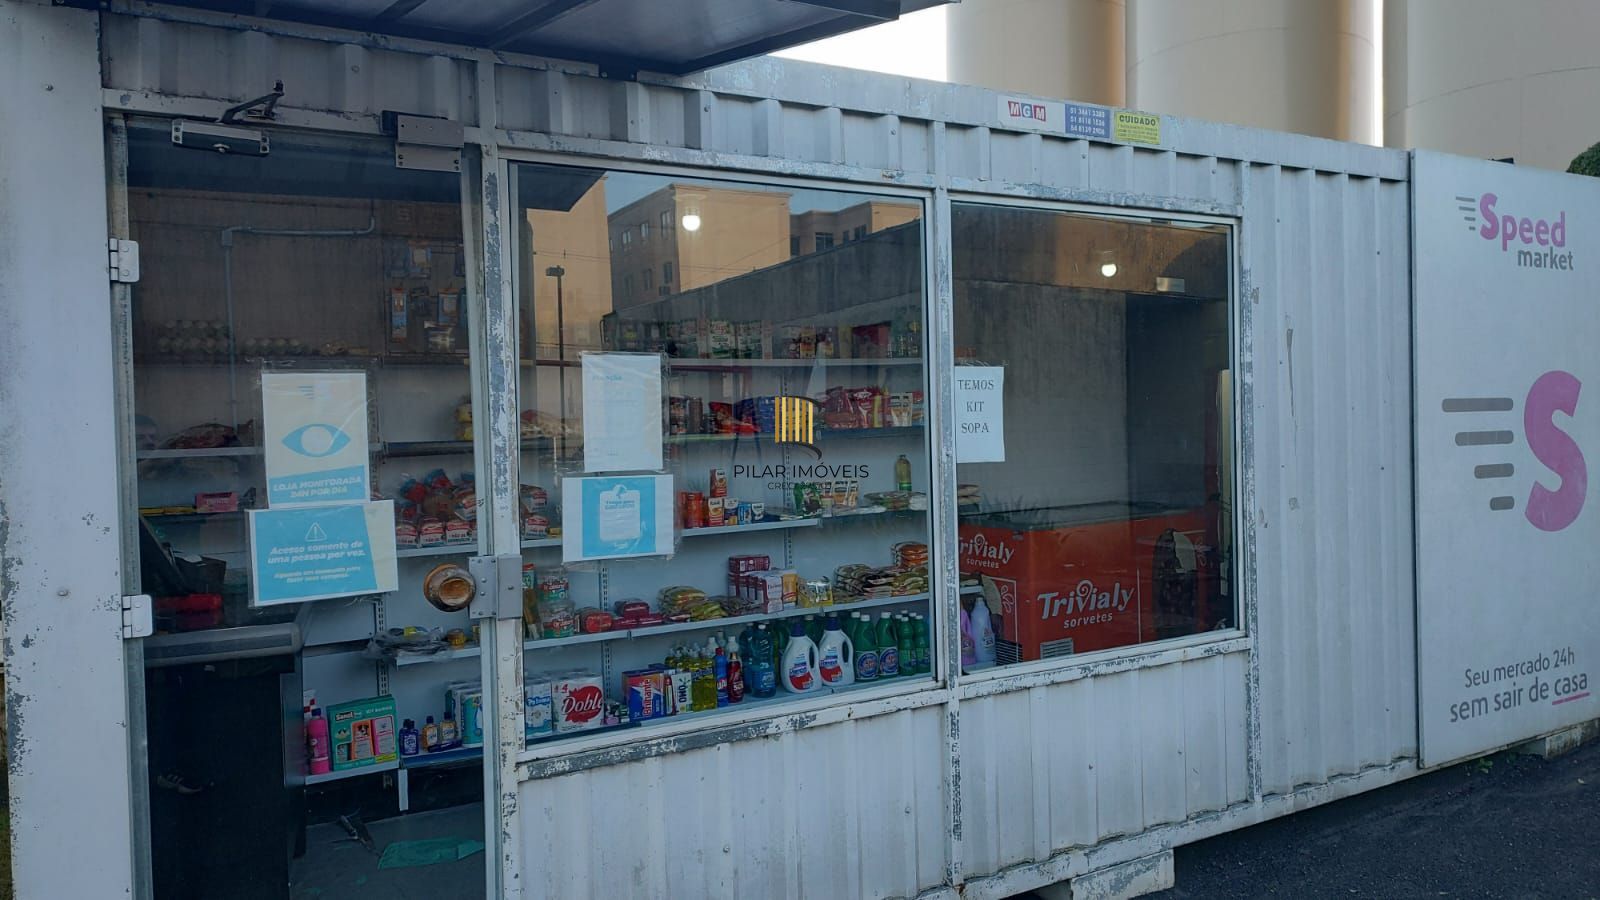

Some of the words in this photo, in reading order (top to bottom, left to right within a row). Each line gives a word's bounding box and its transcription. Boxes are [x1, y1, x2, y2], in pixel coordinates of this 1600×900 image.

[1009, 102, 1046, 121] MGM
[1119, 115, 1156, 126] CUIDADO
[1480, 192, 1566, 251] Speed
[1517, 246, 1574, 271] market
[957, 380, 995, 390] TEMOS
[966, 401, 985, 412] KIT
[961, 422, 990, 433] SOPA
[273, 480, 298, 492] LOJA
[299, 476, 362, 488] MONITORADA
[270, 545, 305, 555] Acesso
[307, 541, 349, 552] somente
[350, 540, 363, 548] de
[959, 533, 1015, 564] rivialy
[268, 555, 289, 564] uma
[291, 553, 326, 564] pessoa
[327, 551, 346, 561] por
[347, 549, 366, 557] vez.
[966, 557, 1000, 568] sorvetes
[1037, 579, 1135, 620] Trivialy
[1063, 612, 1113, 628] sorvetes
[1465, 668, 1490, 688] Seu
[1493, 653, 1550, 682] mercado
[1553, 646, 1575, 668] 24h
[679, 684, 687, 703] OMO
[1450, 696, 1488, 722] sem
[1494, 682, 1523, 711] sair
[1528, 677, 1549, 703] de
[1554, 672, 1588, 696] casa
